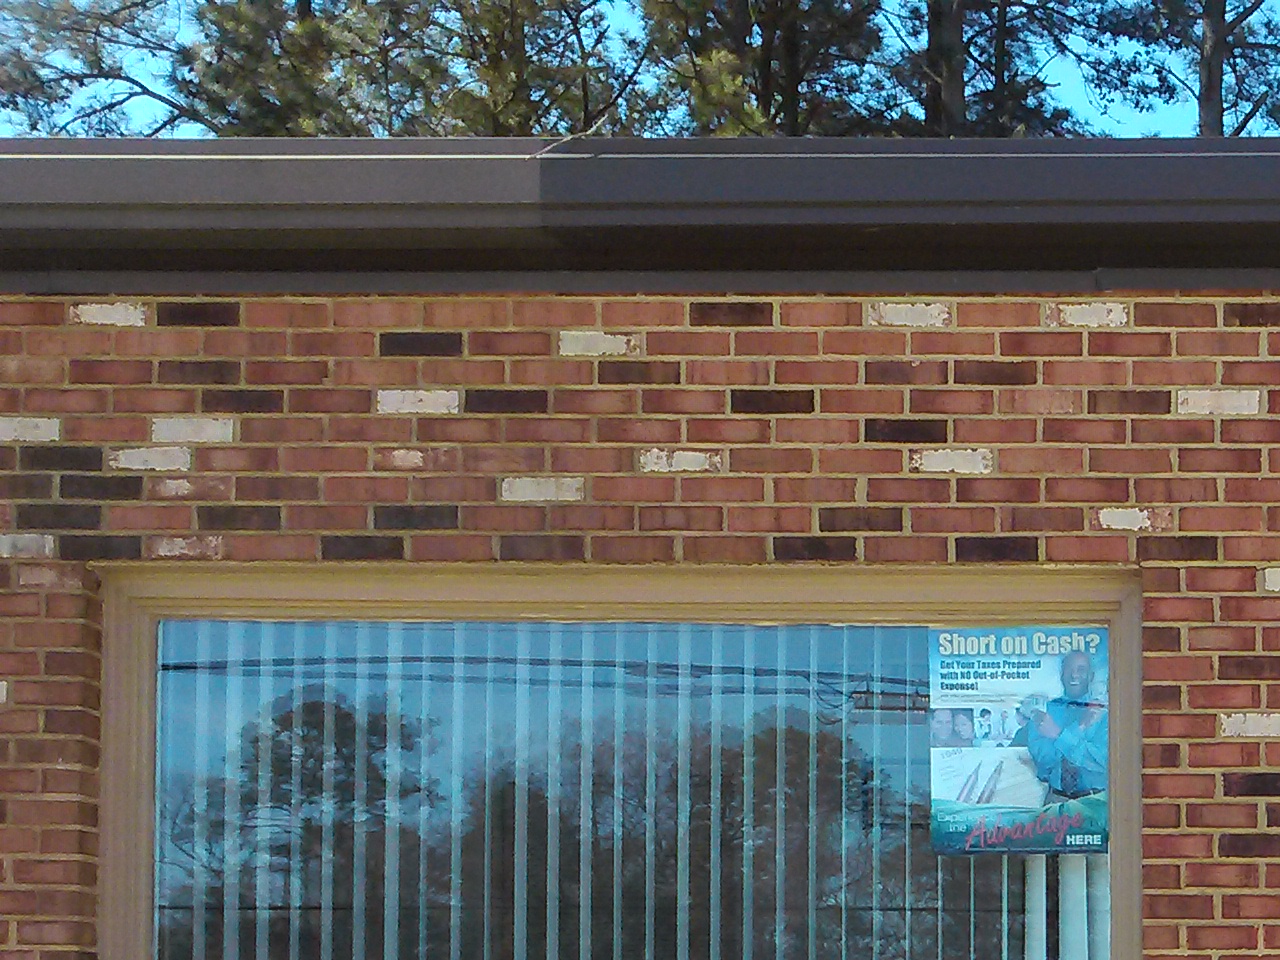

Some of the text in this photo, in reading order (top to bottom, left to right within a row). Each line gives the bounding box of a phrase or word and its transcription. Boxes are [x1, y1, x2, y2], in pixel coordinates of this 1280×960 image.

[938, 631, 1101, 655] Short on Cash?
[940, 660, 1042, 670] Get Your Taxes Prepared
[940, 671, 1031, 680] with NO Out-of-Pocket
[940, 681, 979, 692] Expense!
[1066, 834, 1102, 845] HERE
